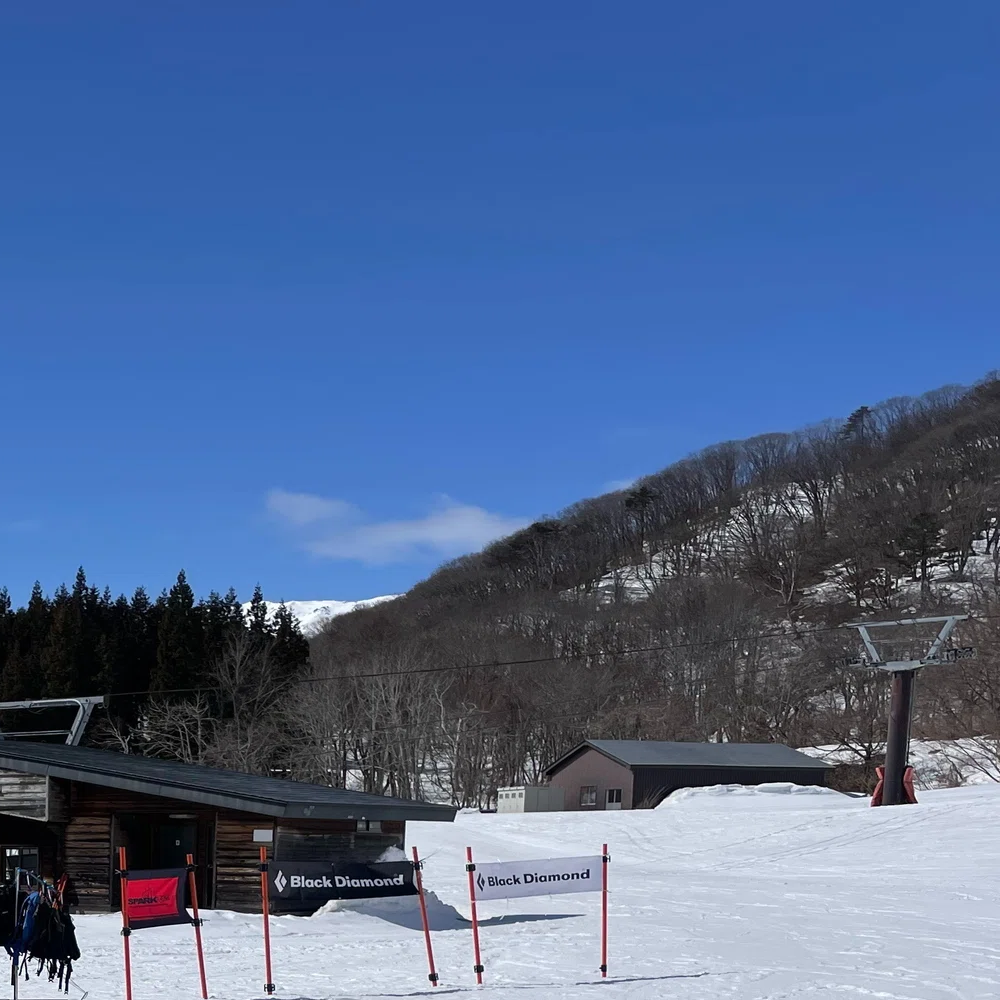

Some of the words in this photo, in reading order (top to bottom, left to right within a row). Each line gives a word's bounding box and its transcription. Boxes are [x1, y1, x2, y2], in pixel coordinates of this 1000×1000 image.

[290, 875, 333, 888] Black
[335, 874, 405, 888] Diamond
[487, 874, 522, 888] Black
[523, 869, 590, 884] Diamond
[128, 897, 158, 905] SPARK
